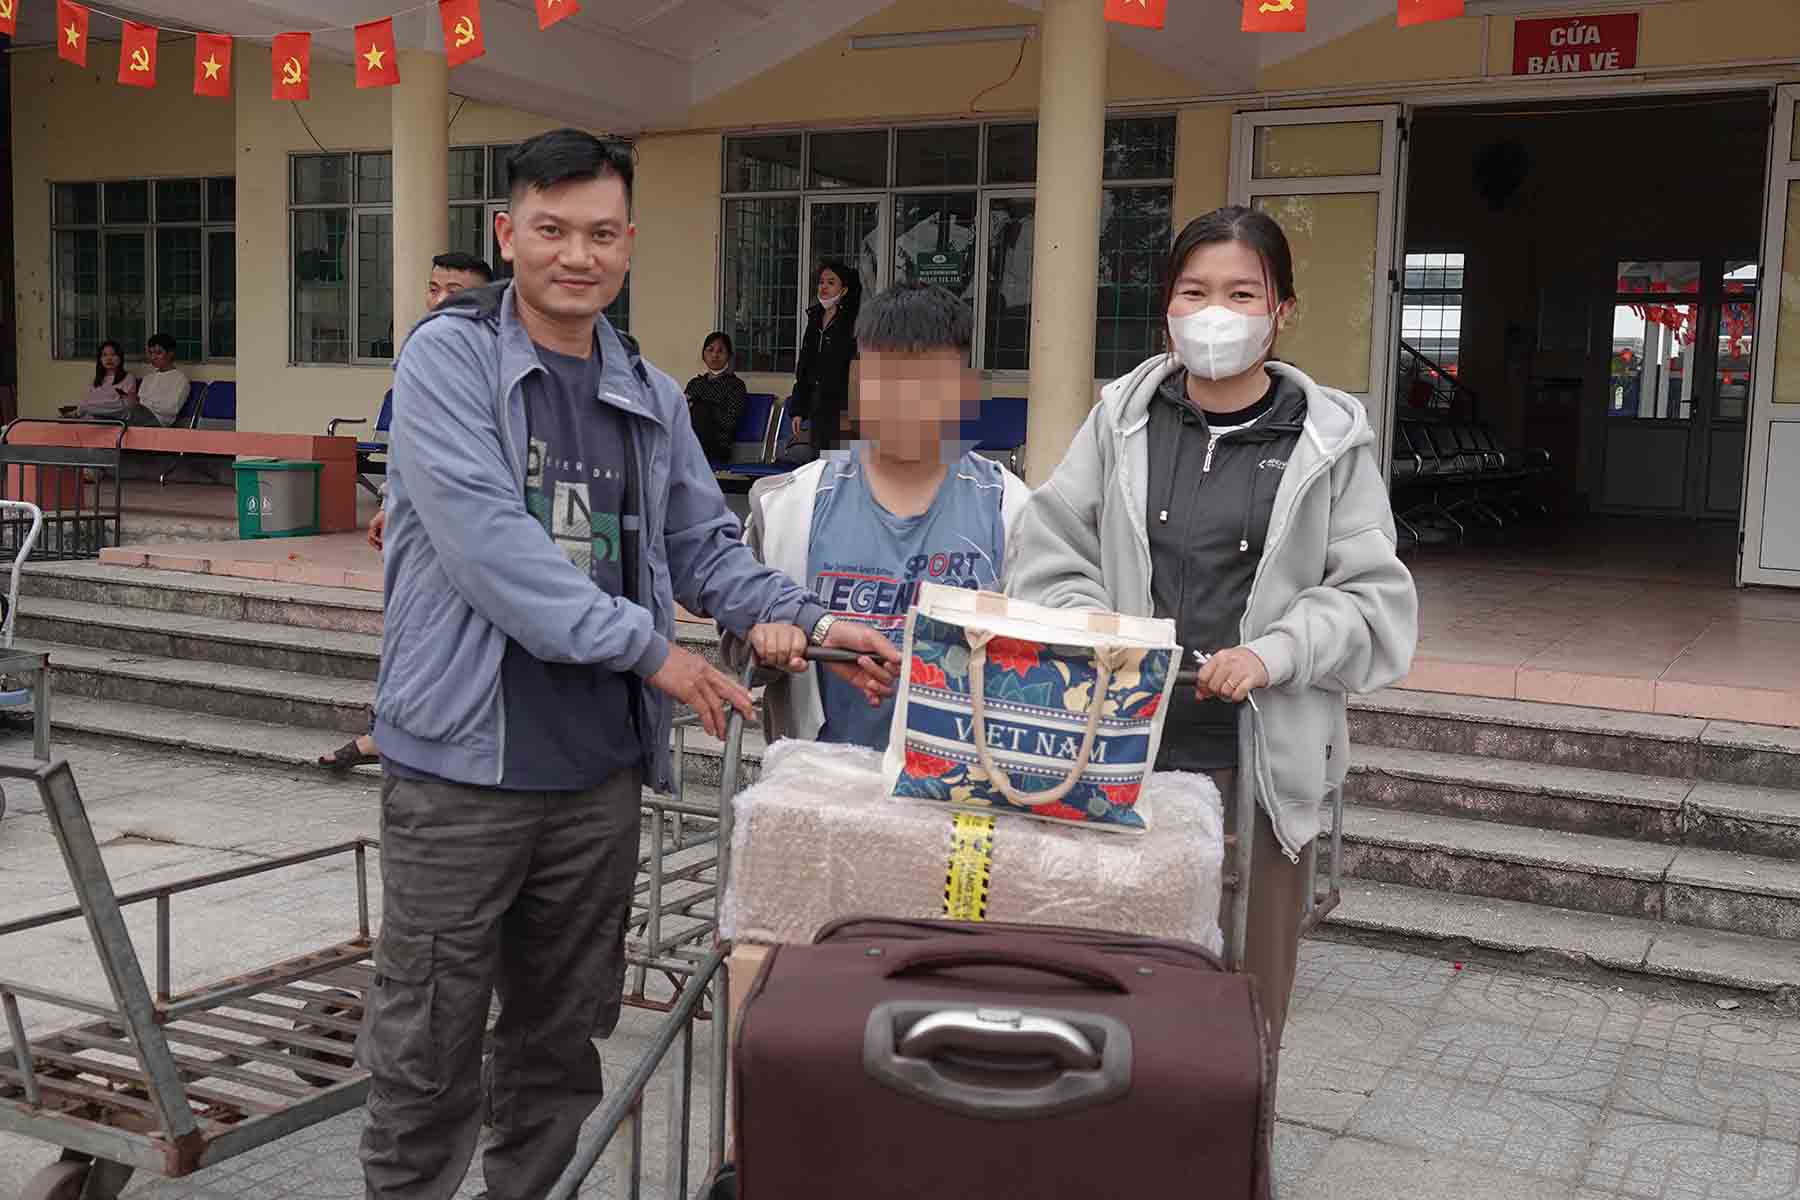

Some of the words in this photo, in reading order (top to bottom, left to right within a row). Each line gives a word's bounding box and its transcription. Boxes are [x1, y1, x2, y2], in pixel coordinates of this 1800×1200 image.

[1551, 20, 1601, 46] CỬA
[1528, 51, 1580, 74] BÁN
[1589, 48, 1620, 70] VÉ
[904, 552, 981, 580] SPORT
[954, 717, 1026, 750] VET
